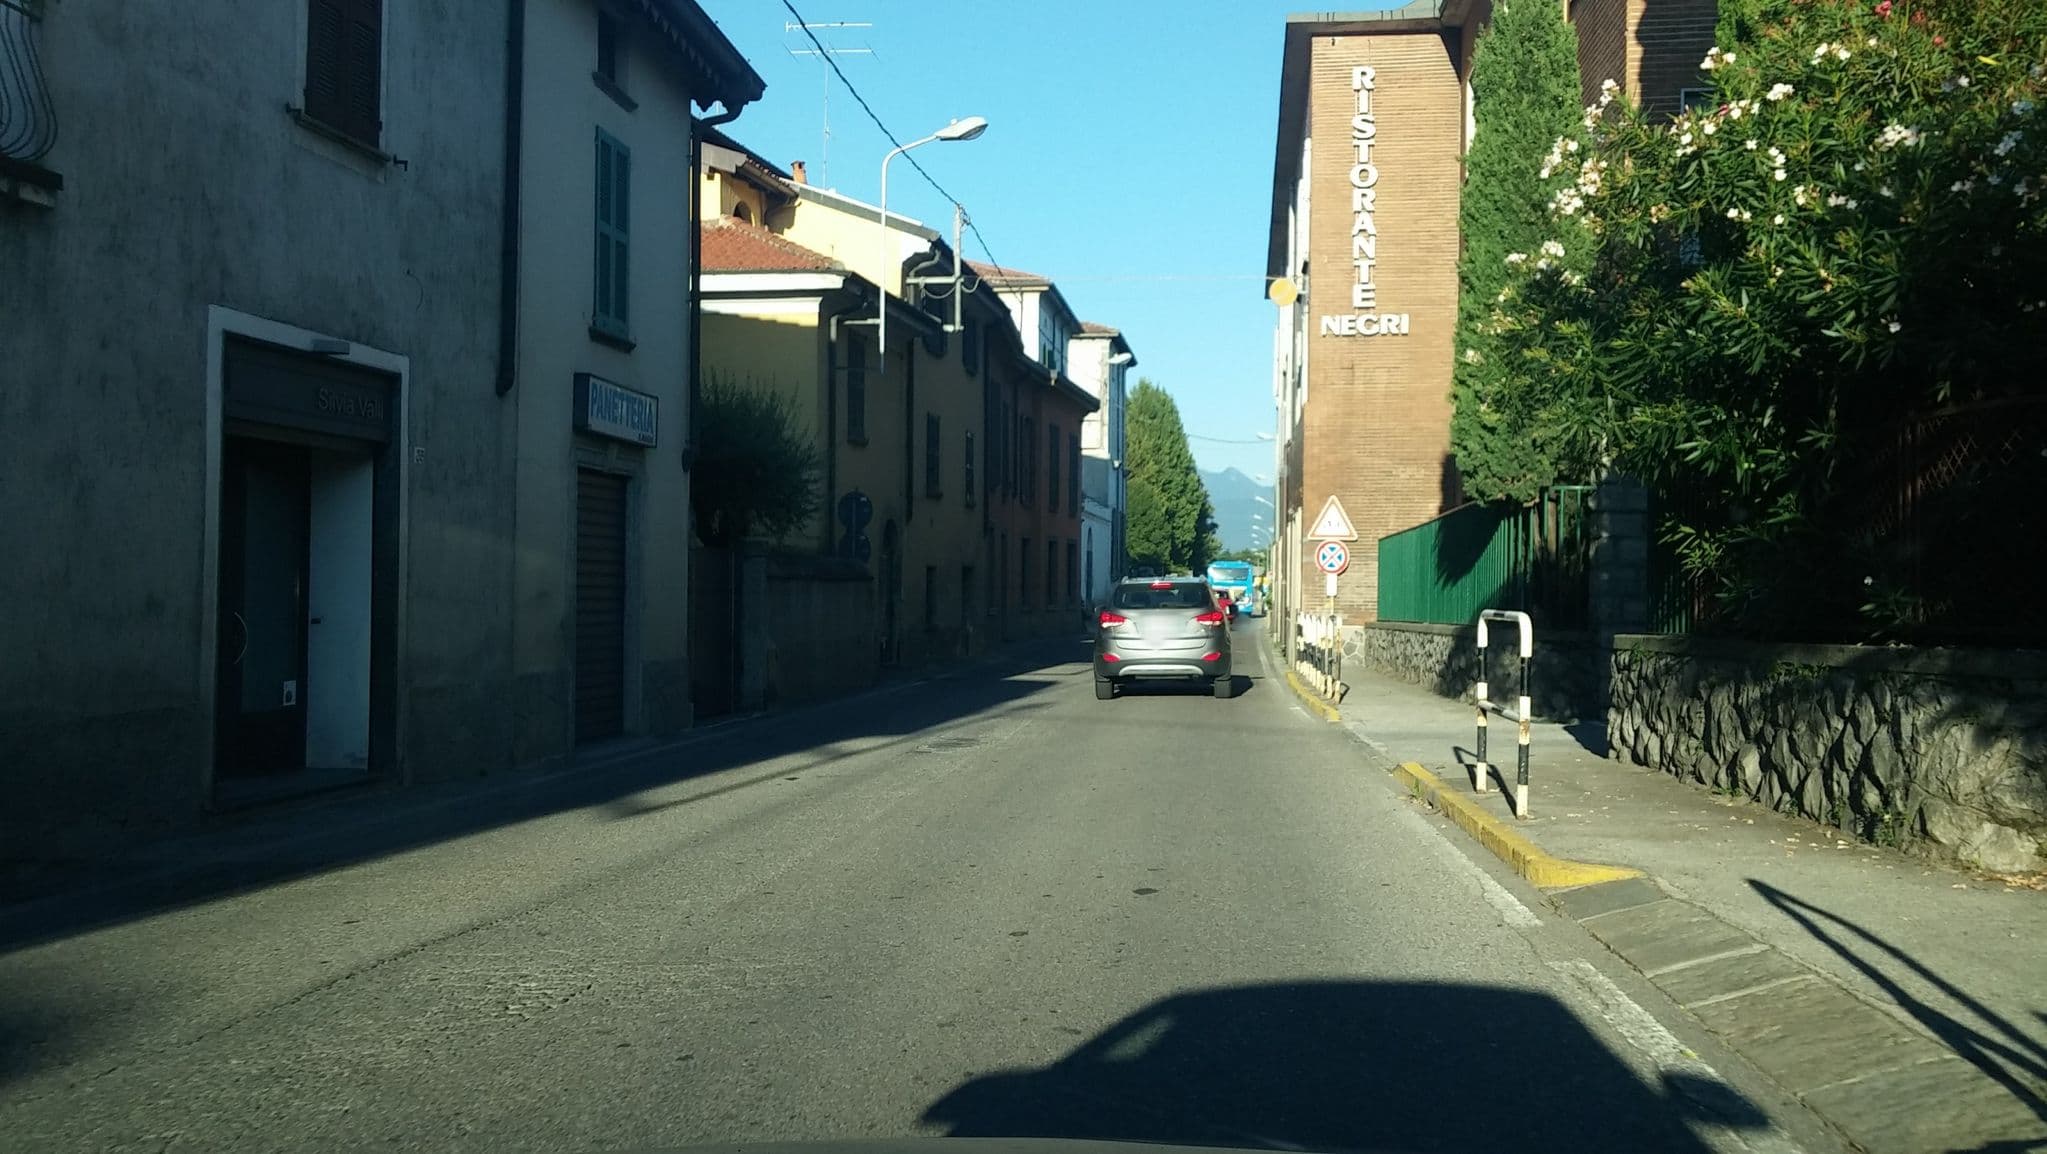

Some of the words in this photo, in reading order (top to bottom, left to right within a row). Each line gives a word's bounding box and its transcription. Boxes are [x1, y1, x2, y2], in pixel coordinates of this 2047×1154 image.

[1349, 66, 1379, 308] RISTORANTE
[1320, 314, 1410, 336] NEGRI
[319, 387, 354, 414] Silvia
[591, 382, 655, 433] PANETTERIA
